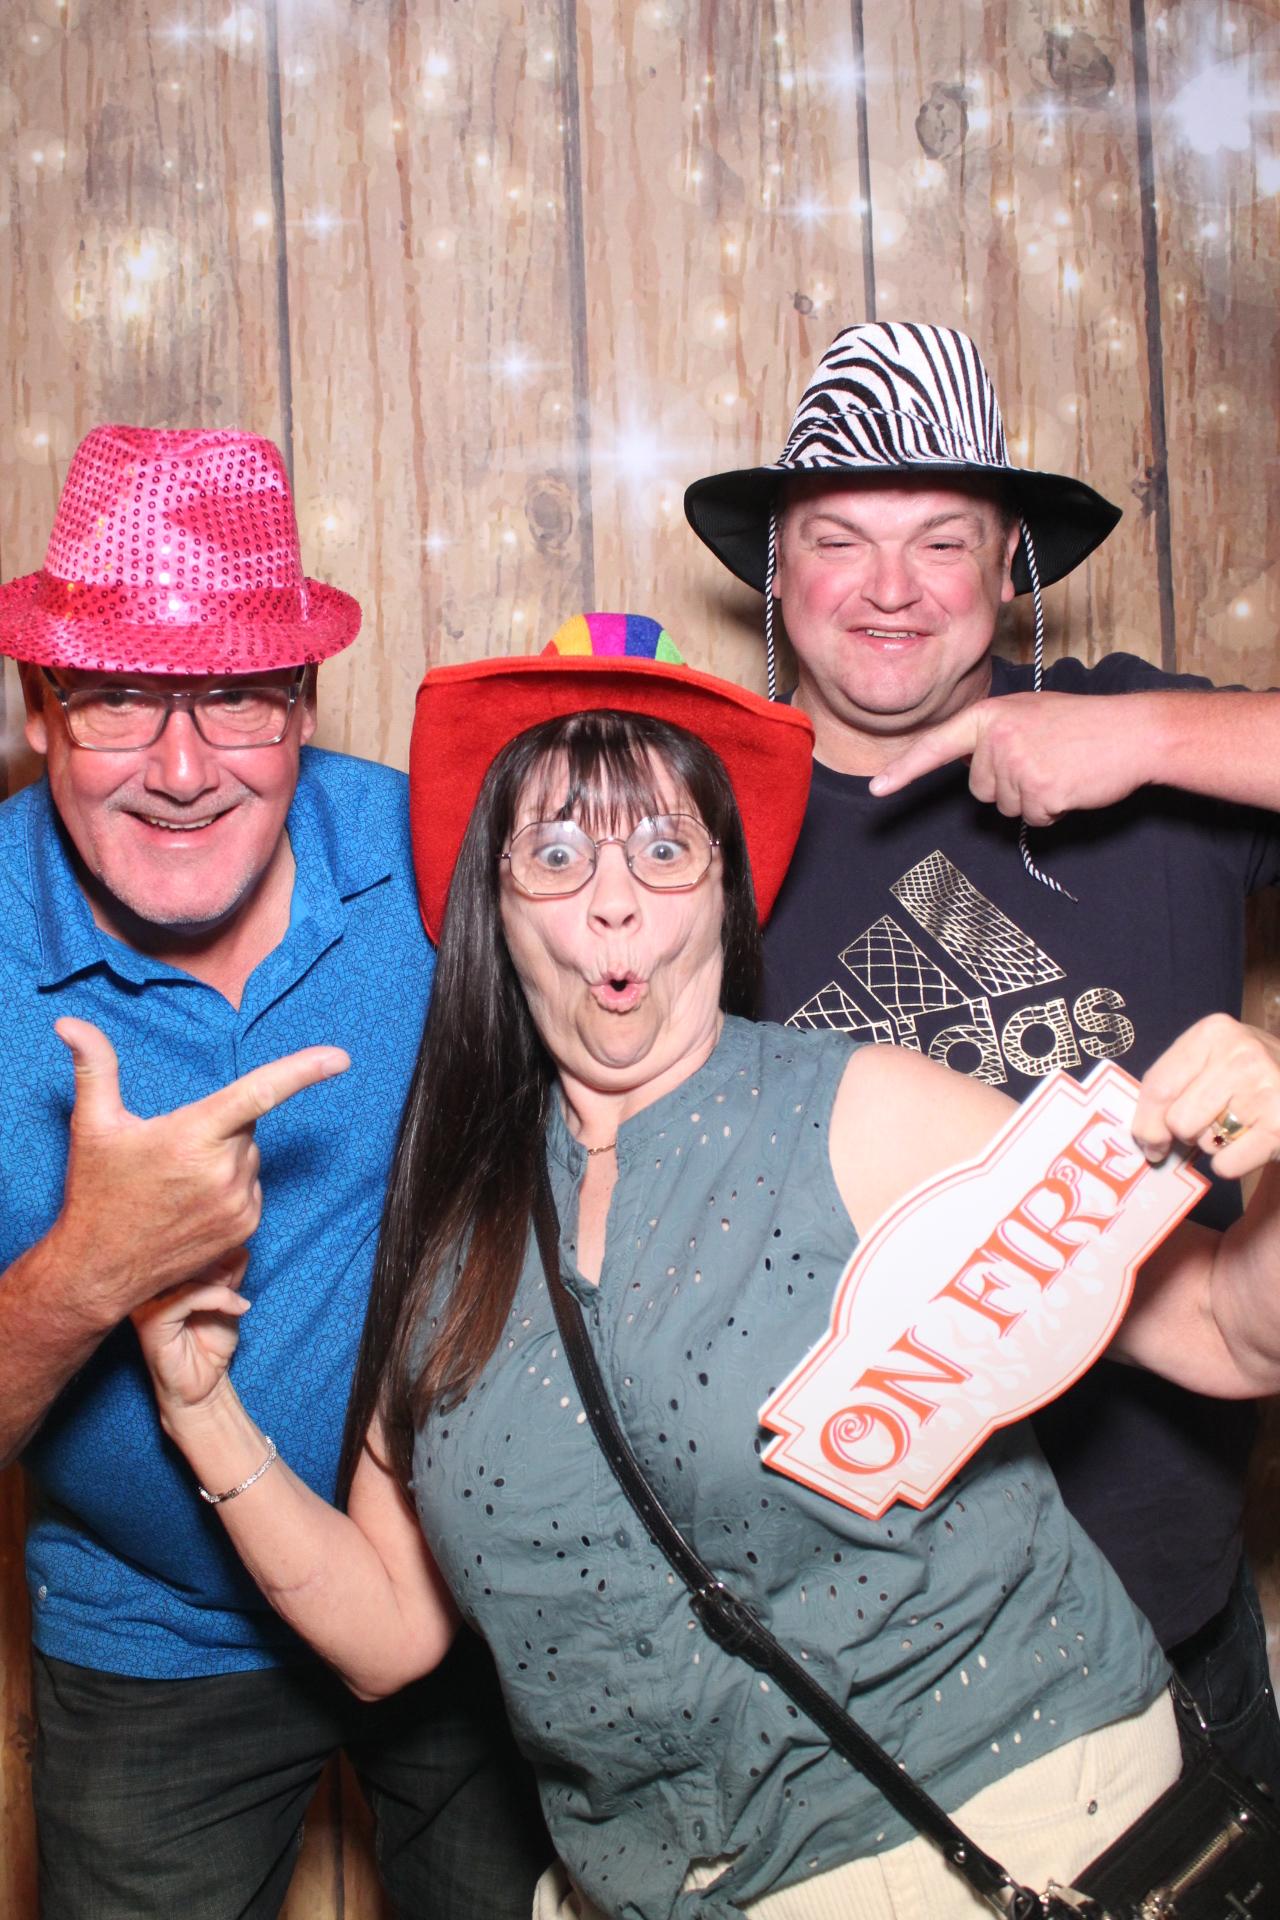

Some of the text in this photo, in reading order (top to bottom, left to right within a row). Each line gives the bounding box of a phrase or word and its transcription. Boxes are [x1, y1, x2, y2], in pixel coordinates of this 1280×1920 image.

[872, 988, 1135, 1086] das
[820, 1109, 1150, 1475] ON FIRE
